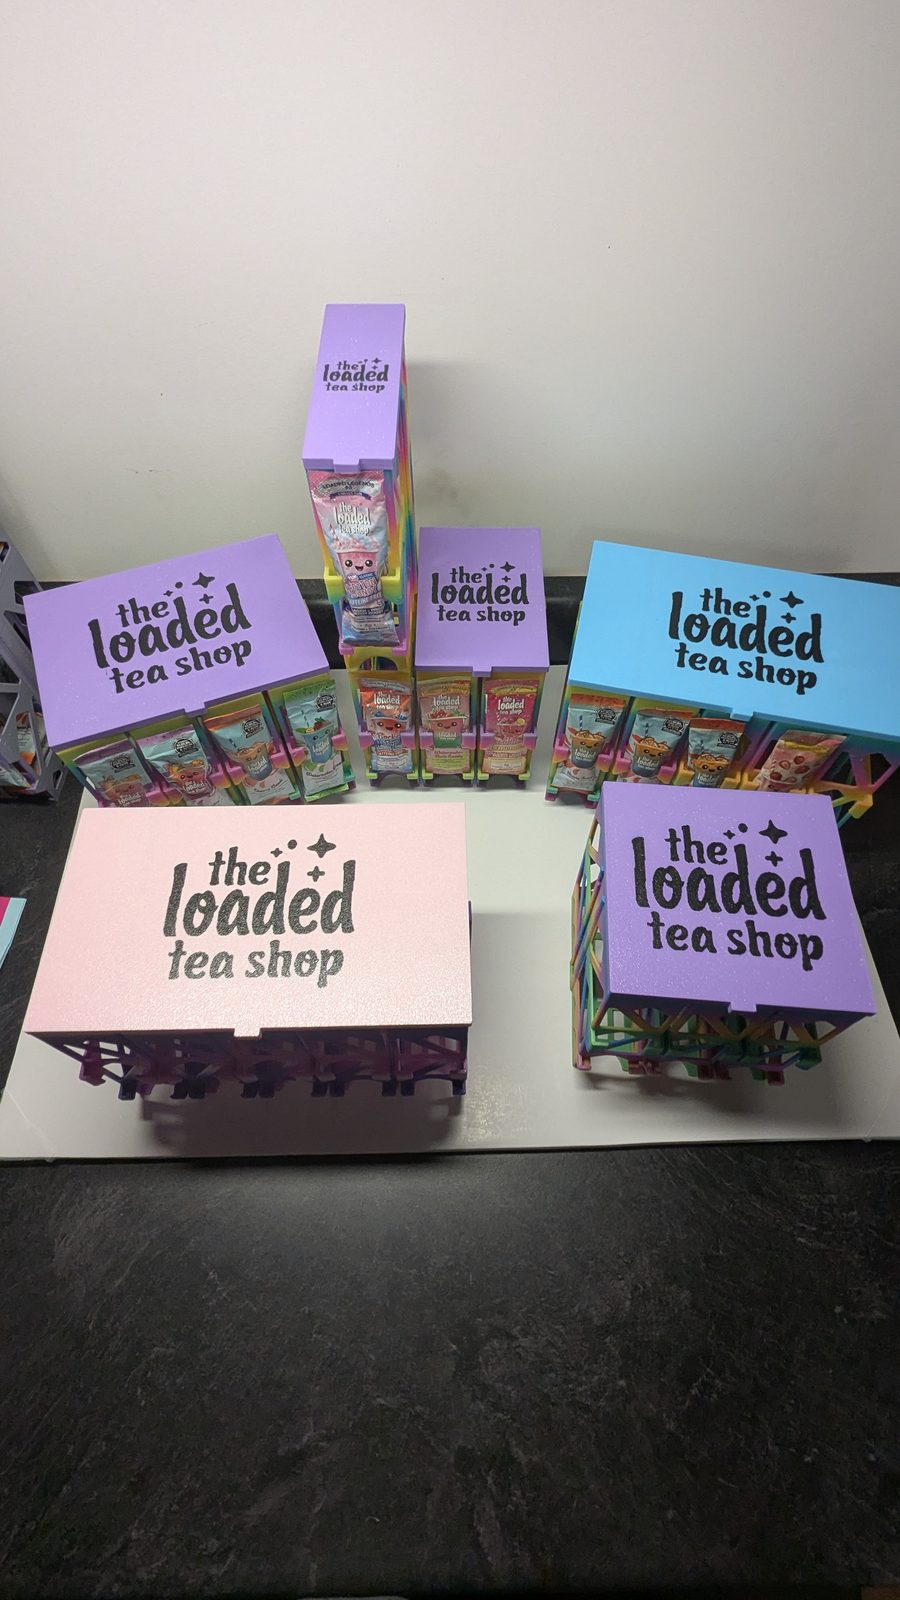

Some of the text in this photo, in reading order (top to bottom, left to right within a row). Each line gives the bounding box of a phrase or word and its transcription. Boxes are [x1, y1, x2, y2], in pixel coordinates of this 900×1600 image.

[323, 364, 389, 382] loaded
[336, 360, 359, 371] the
[325, 382, 385, 394] tea shop
[334, 507, 371, 525] loaded
[339, 501, 353, 512] the
[432, 573, 530, 605] loaded
[450, 565, 484, 584] the
[116, 590, 170, 629] the
[436, 604, 526, 626] tea shop
[701, 588, 749, 619] the
[88, 583, 252, 669] loaded
[669, 591, 825, 664] loaded
[108, 640, 252, 694] tea shop
[674, 642, 818, 696] tea shop
[373, 693, 400, 704] loaded
[433, 696, 460, 707] loaded
[498, 698, 525, 711] loaded
[661, 827, 728, 868] the
[209, 847, 270, 886] the
[632, 836, 828, 921] loaded
[164, 860, 356, 937] loaded
[647, 911, 824, 972] tea shop
[168, 940, 344, 987] tea shop
